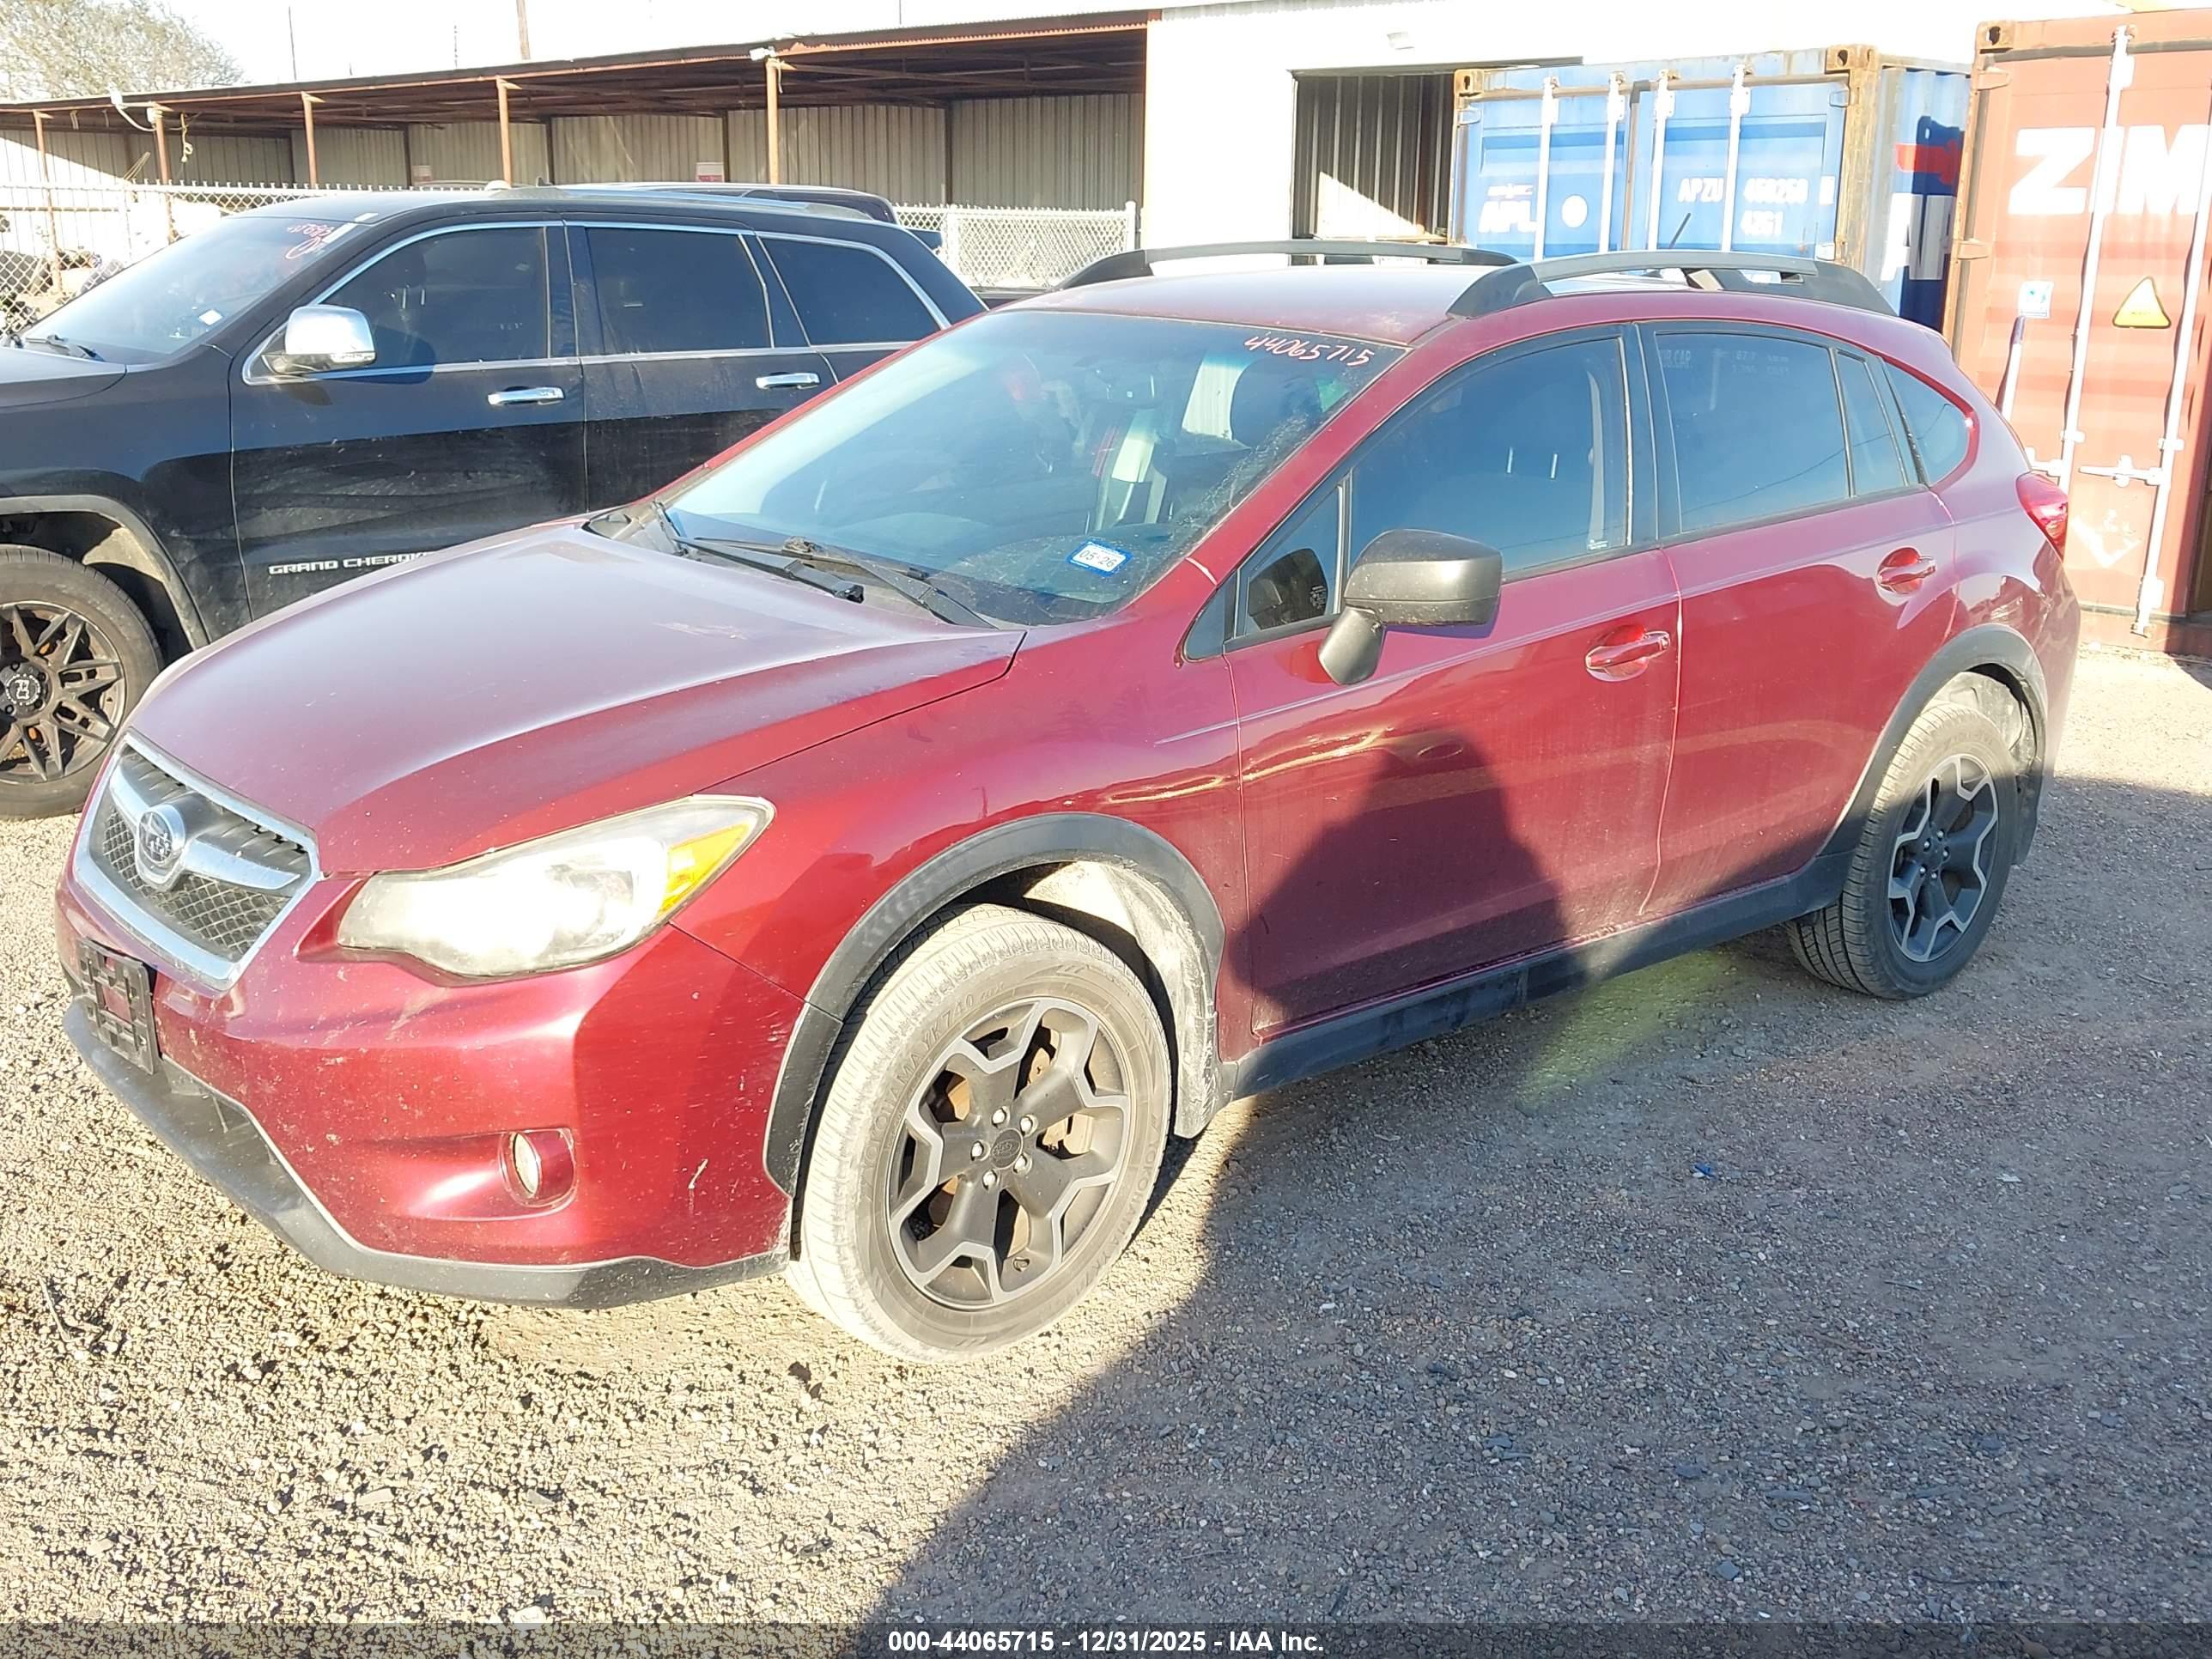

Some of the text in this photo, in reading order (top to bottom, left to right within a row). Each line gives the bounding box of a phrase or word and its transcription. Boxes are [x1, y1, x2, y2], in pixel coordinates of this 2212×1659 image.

[2008, 125, 2212, 215] ZIM
[1244, 332, 1375, 367] 44065715
[268, 560, 338, 575] GRAND
[855, 1051, 922, 1169] YOKOHAMA
